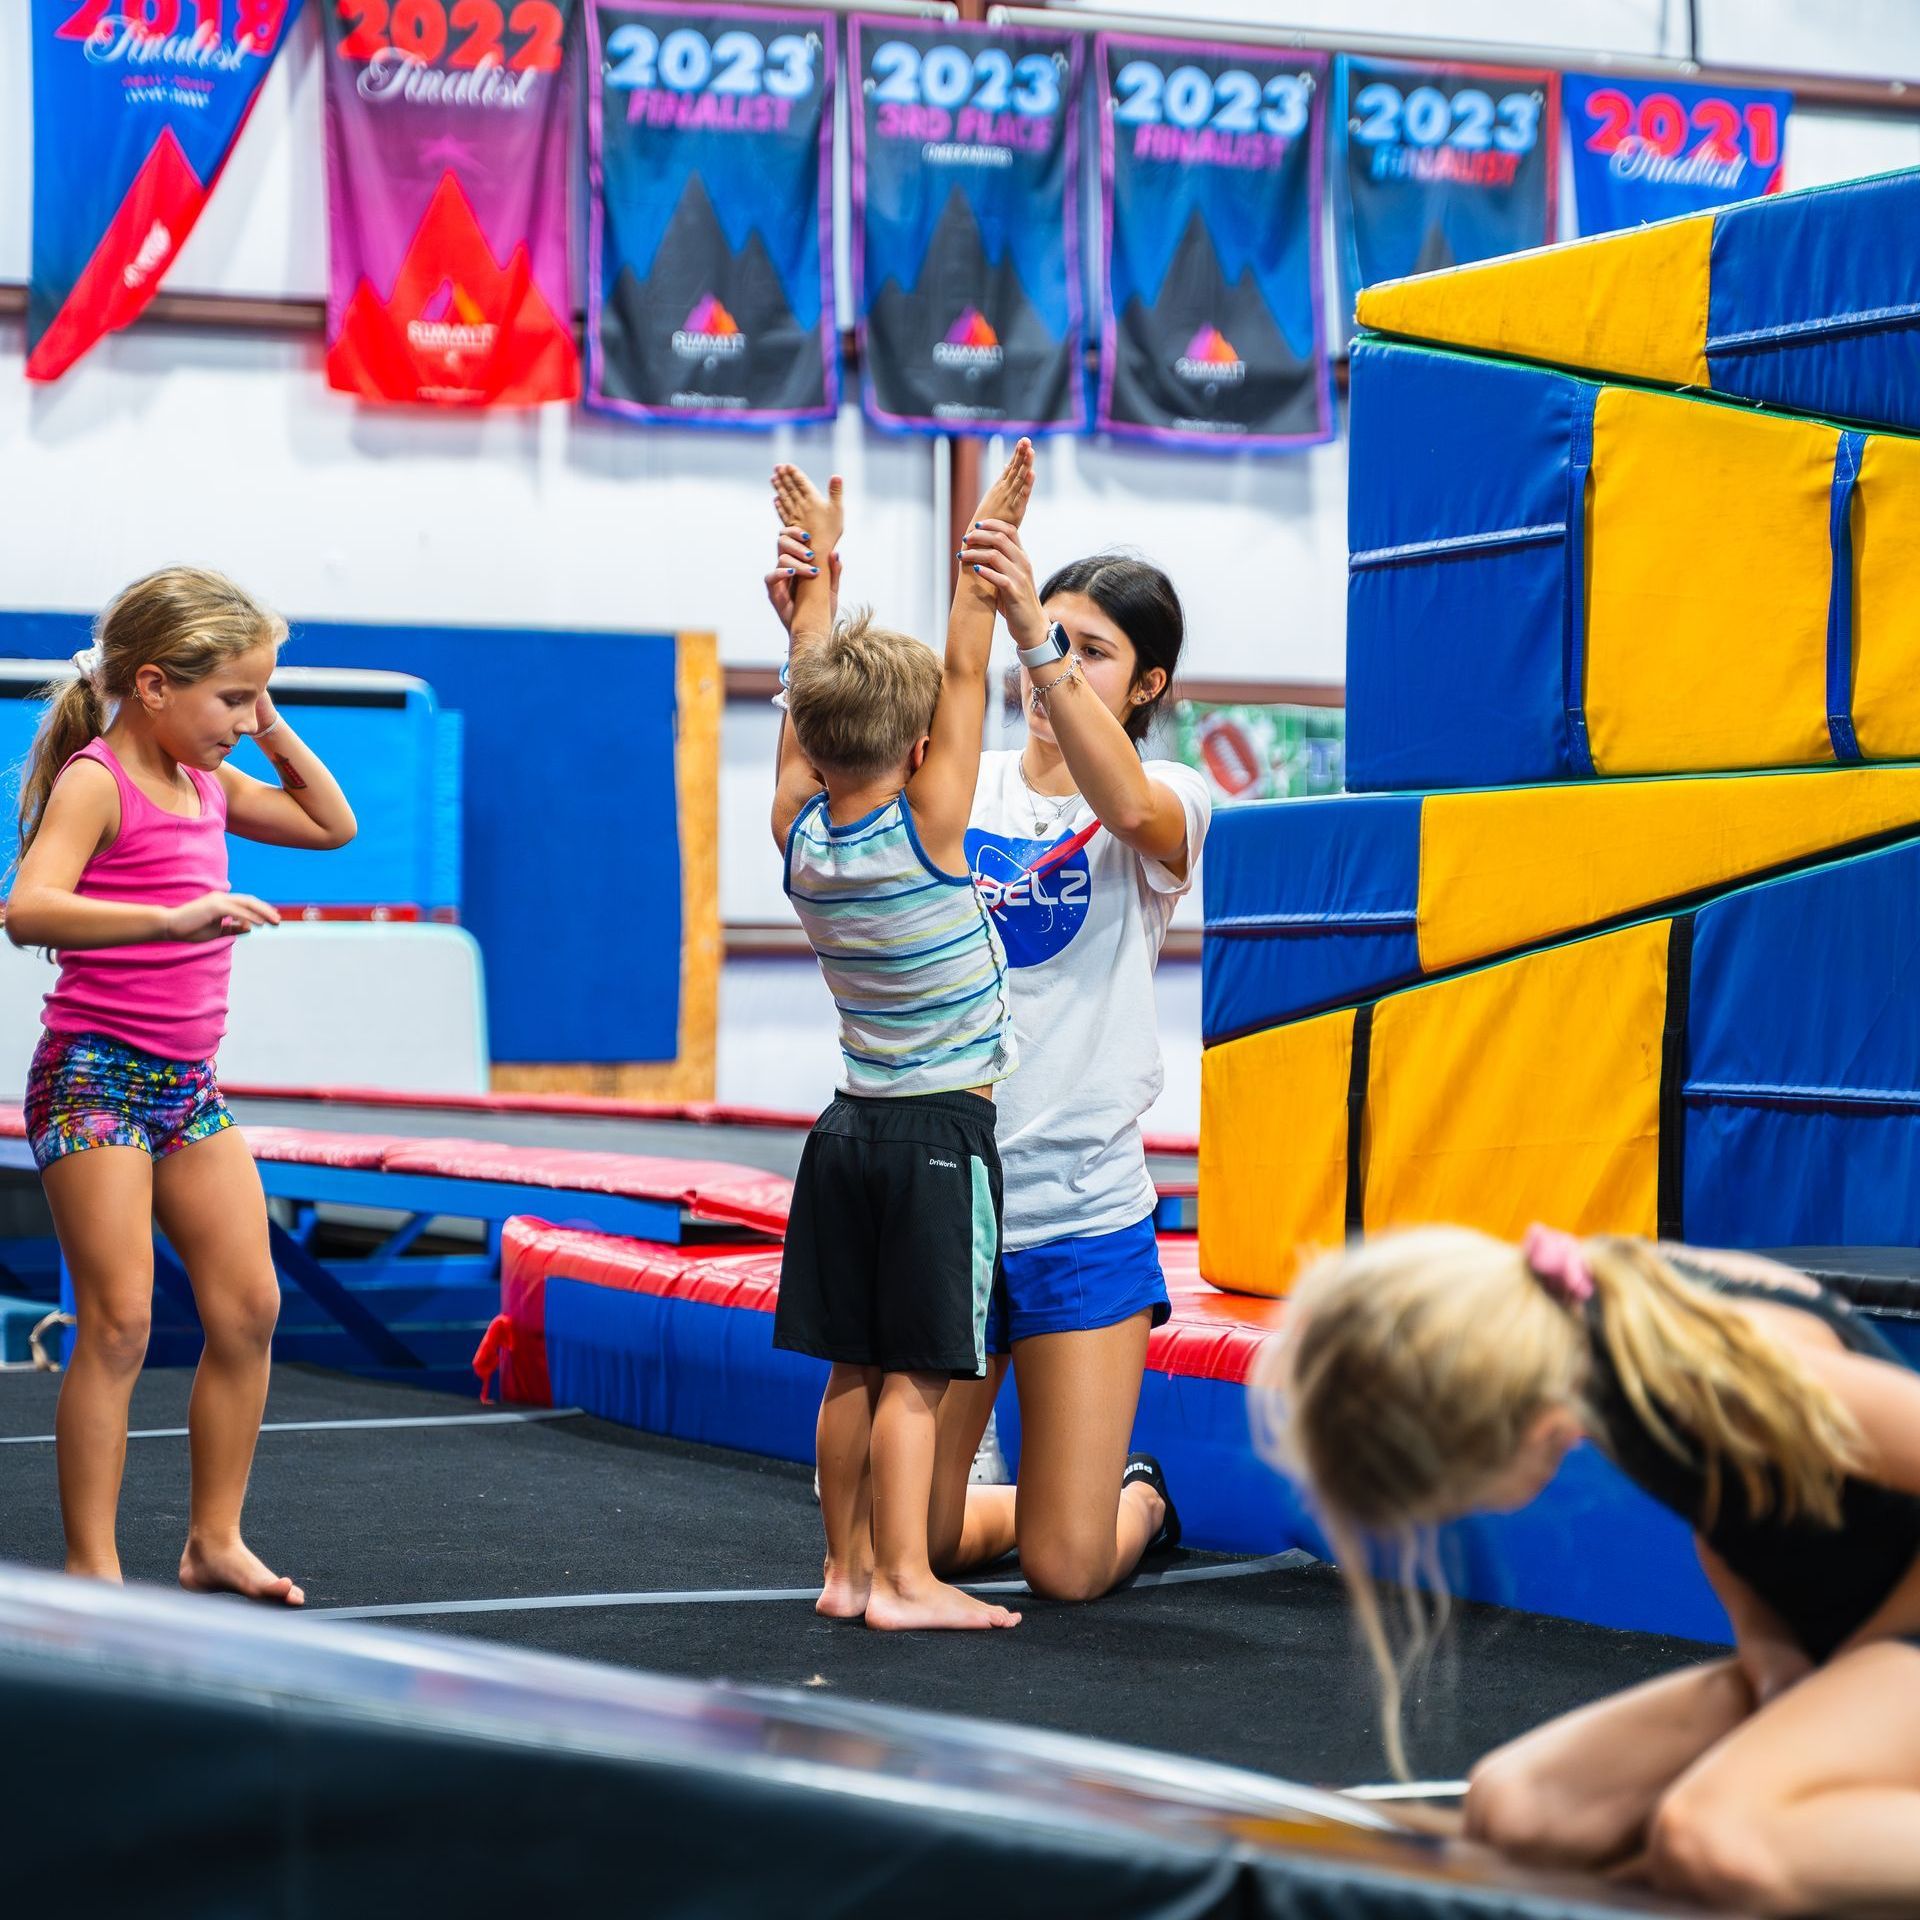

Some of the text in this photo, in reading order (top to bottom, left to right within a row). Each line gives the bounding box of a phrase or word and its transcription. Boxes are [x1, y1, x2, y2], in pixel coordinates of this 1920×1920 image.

[83, 14, 255, 71] Finalist
[337, 0, 563, 73] 2022
[604, 23, 815, 98] 2023
[356, 47, 538, 107] Finalist
[873, 40, 1060, 118] 2023
[1114, 60, 1309, 138] 2023
[626, 88, 794, 131] FINALIST
[876, 102, 1053, 153] 3RD PLACE
[1355, 82, 1540, 154] 2023
[1584, 88, 1778, 168] 2021
[1134, 123, 1289, 170] FINALIST
[1371, 143, 1521, 186] FINALIST
[1609, 135, 1749, 188] Finalist
[929, 1158, 957, 1169] DriWorks
